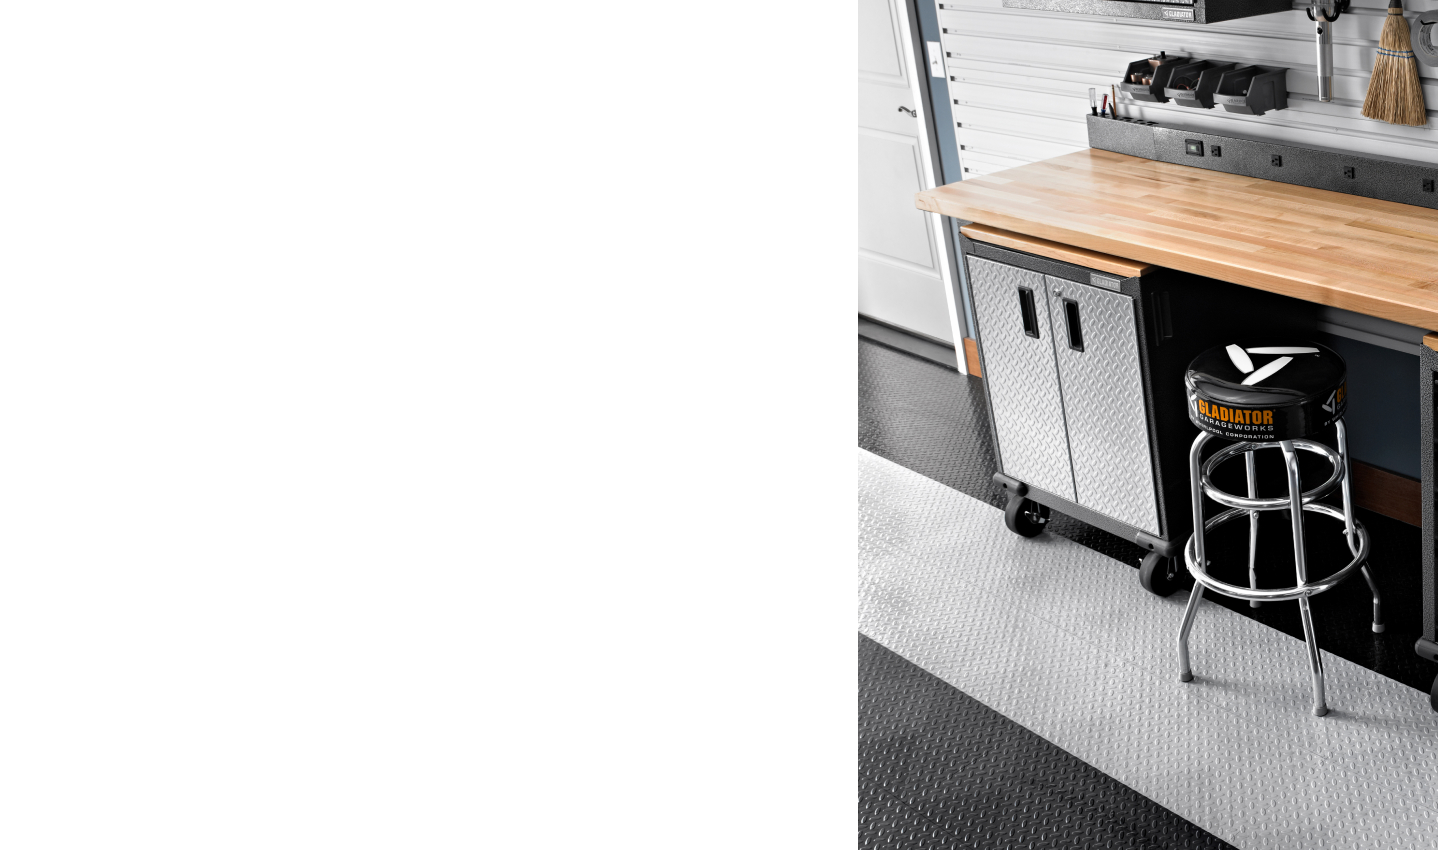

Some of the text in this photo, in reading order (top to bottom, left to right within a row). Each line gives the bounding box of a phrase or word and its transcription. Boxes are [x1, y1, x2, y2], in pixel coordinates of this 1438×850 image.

[1198, 399, 1273, 425] GLADIATOR
[1199, 413, 1274, 432] GARAGEWORKS
[1225, 431, 1275, 439] CORPORATION
